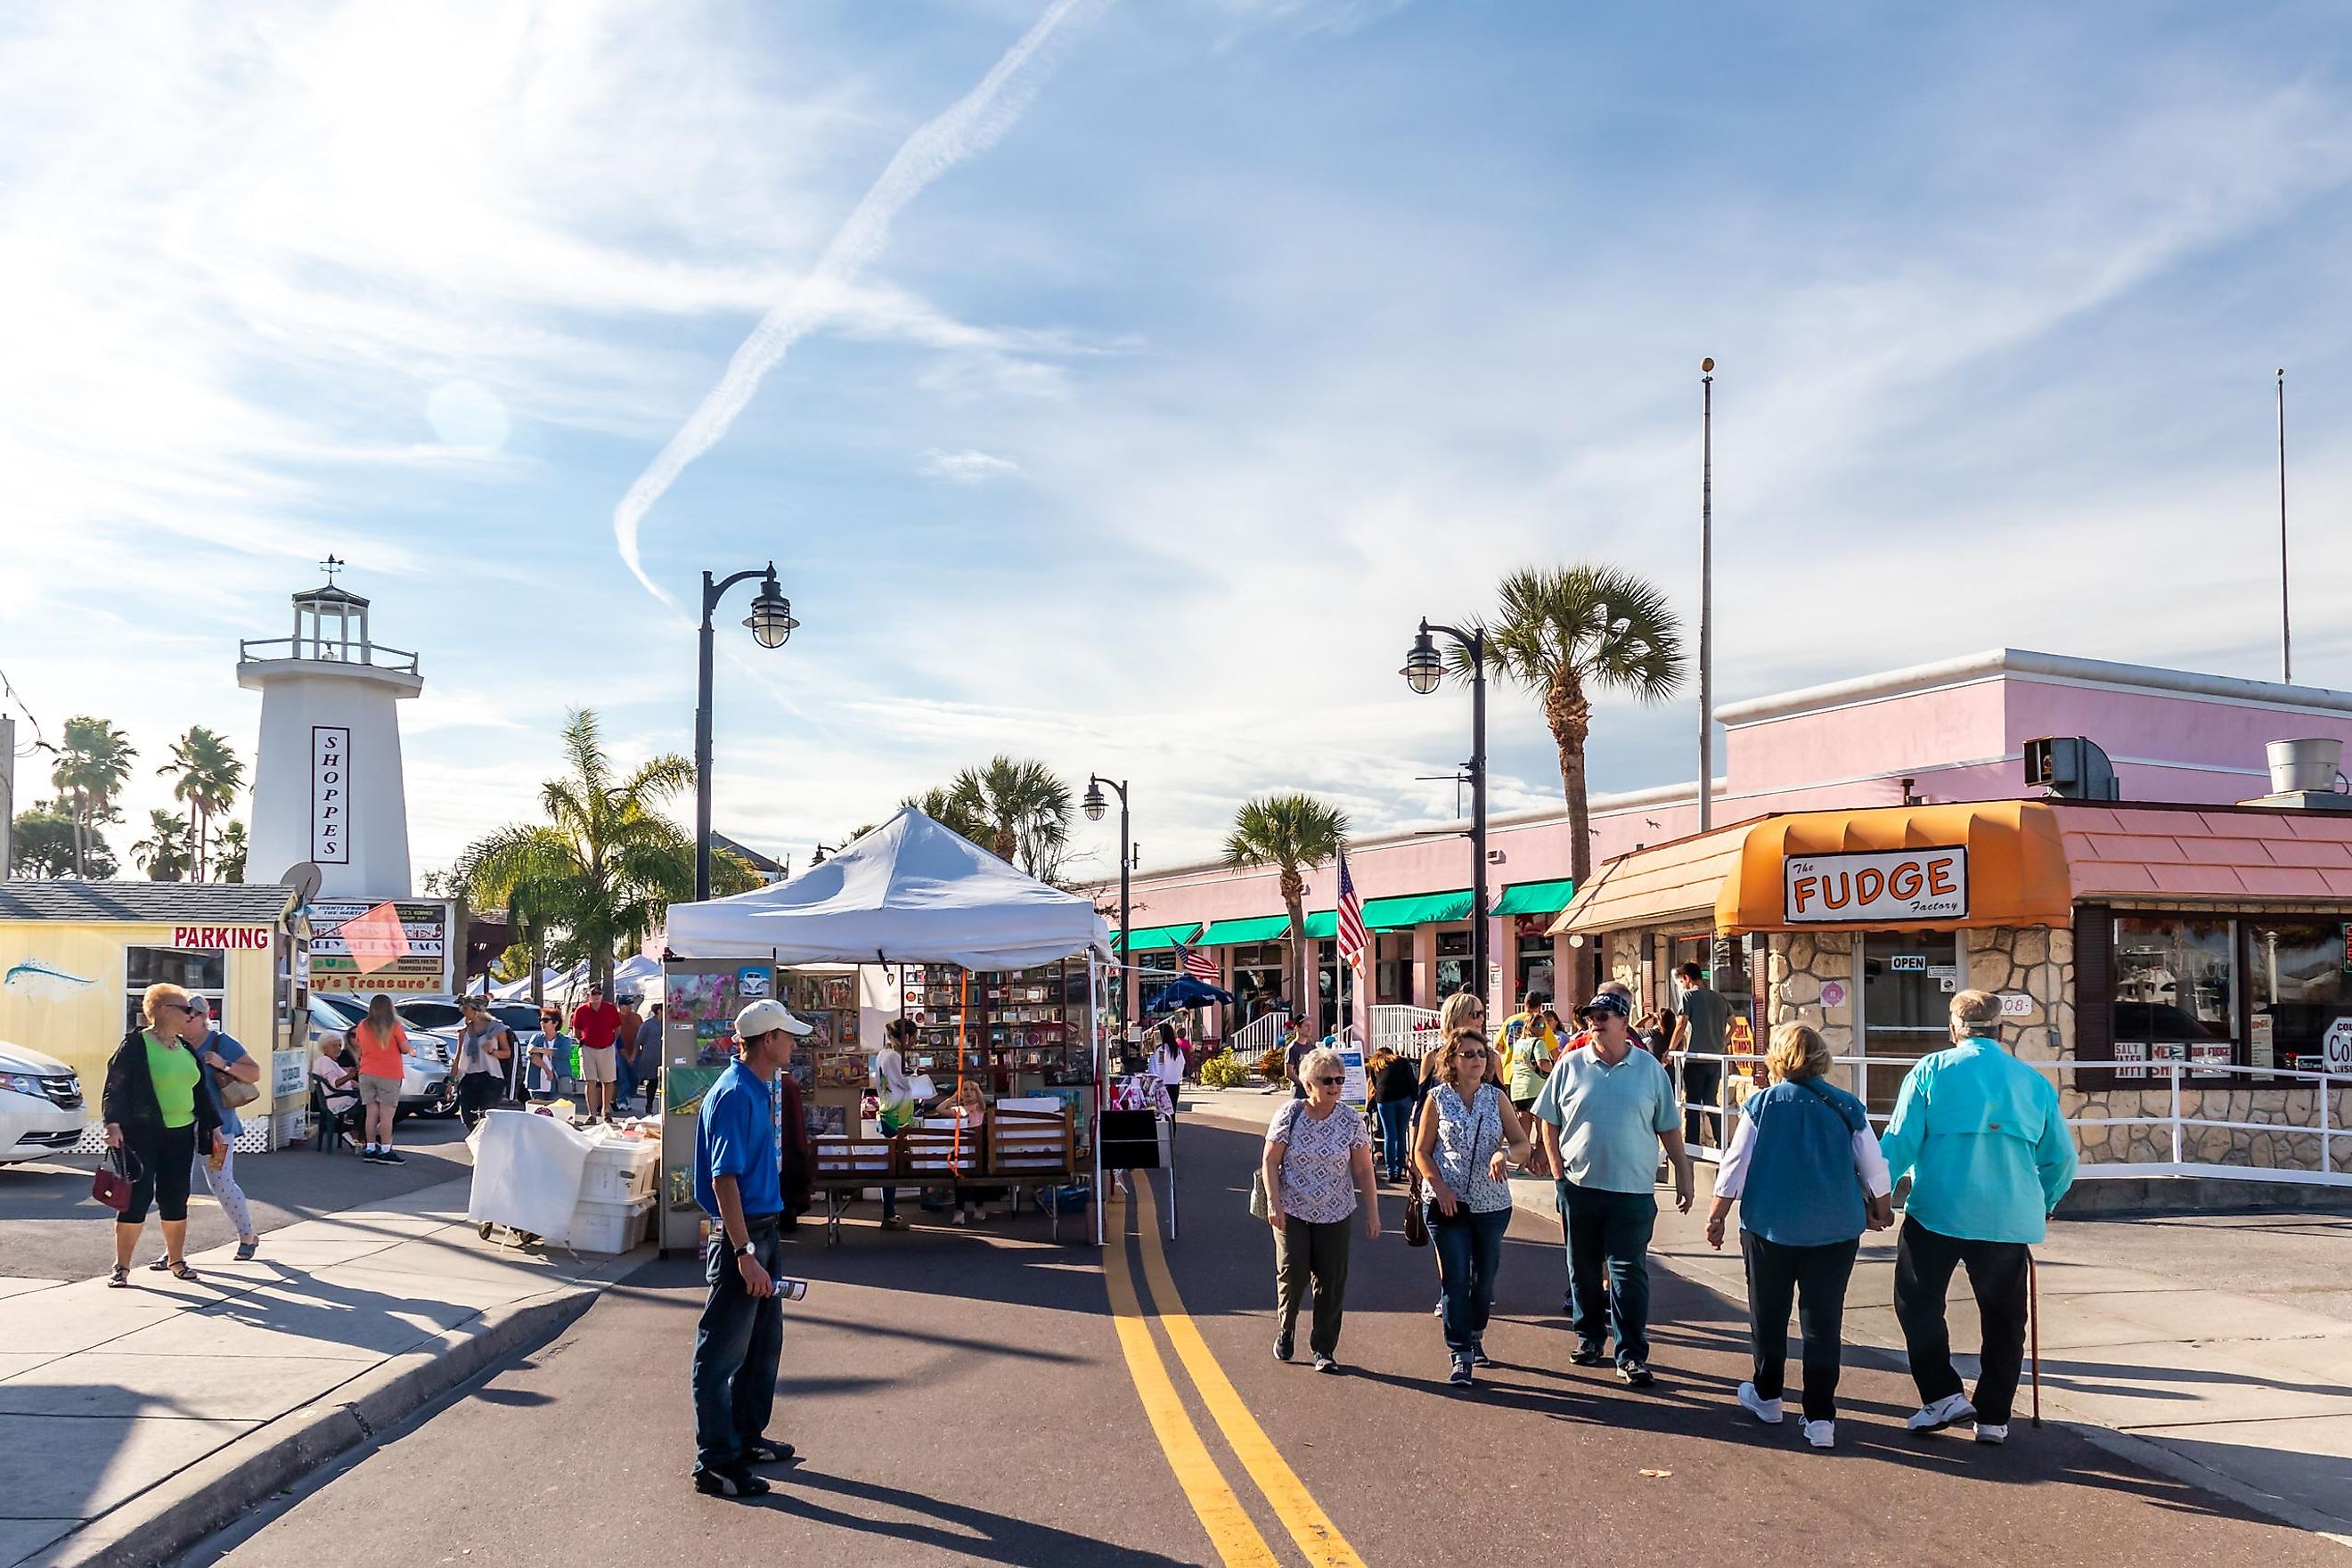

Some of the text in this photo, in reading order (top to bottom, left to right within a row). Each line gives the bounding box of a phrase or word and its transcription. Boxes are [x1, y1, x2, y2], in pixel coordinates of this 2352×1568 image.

[322, 736, 340, 854] SHOPPES
[1793, 862, 1815, 874] The
[1793, 857, 1957, 913] FUDGE
[1909, 901, 1958, 913] Factory
[175, 927, 268, 949] PARKING
[1893, 958, 1924, 968] OPEN
[346, 976, 440, 990] Treasure's
[2005, 999, 2023, 1012] 08
[2115, 1044, 2139, 1055] SALT
